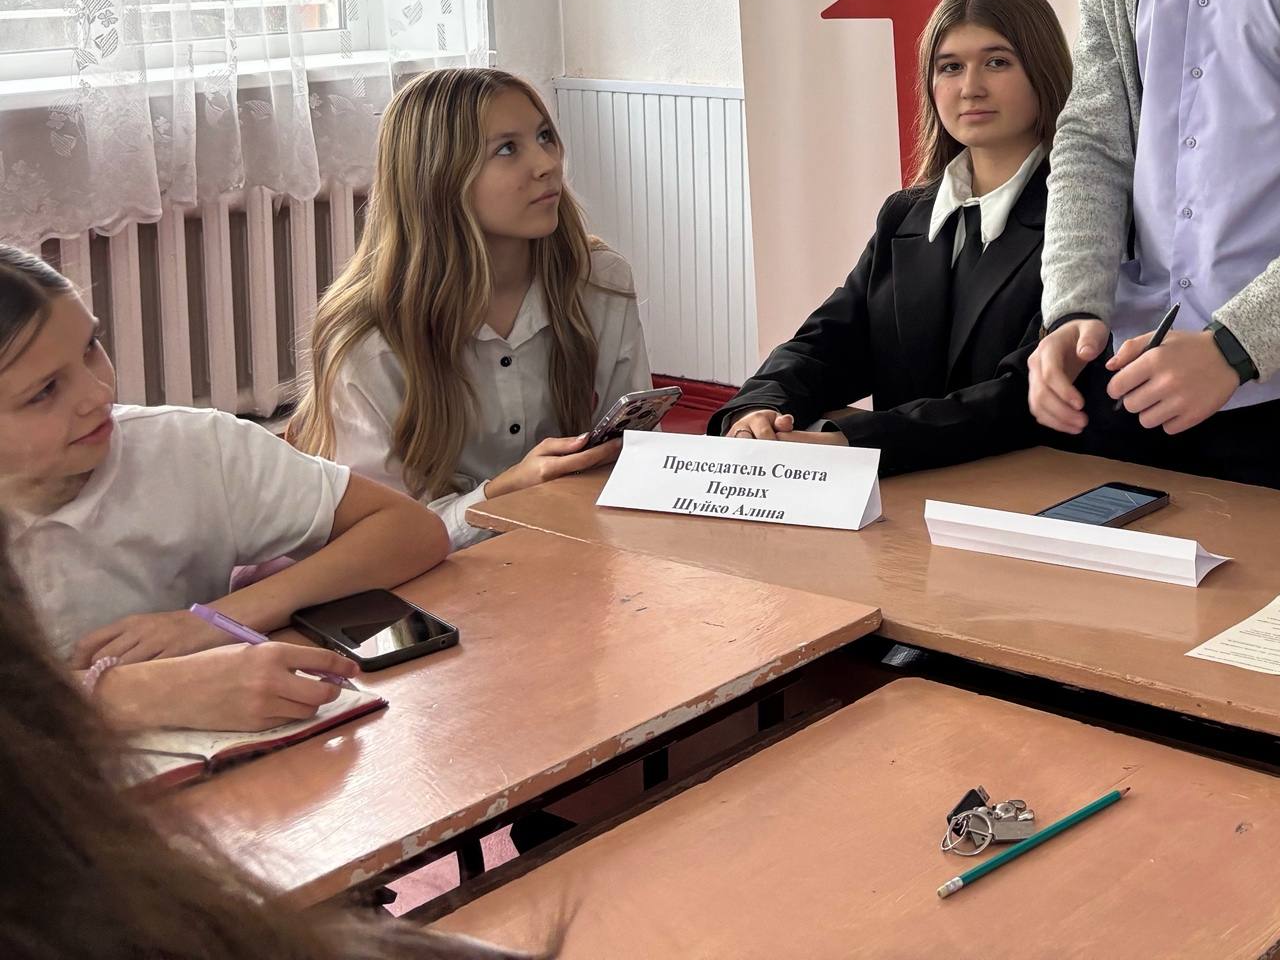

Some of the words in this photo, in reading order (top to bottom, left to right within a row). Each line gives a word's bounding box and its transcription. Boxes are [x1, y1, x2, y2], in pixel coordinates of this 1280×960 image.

[662, 455, 767, 478] Председатель
[771, 463, 828, 482] Совета
[706, 480, 769, 499] Первых
[672, 497, 730, 515] Шуйко
[733, 504, 785, 520] Алина
